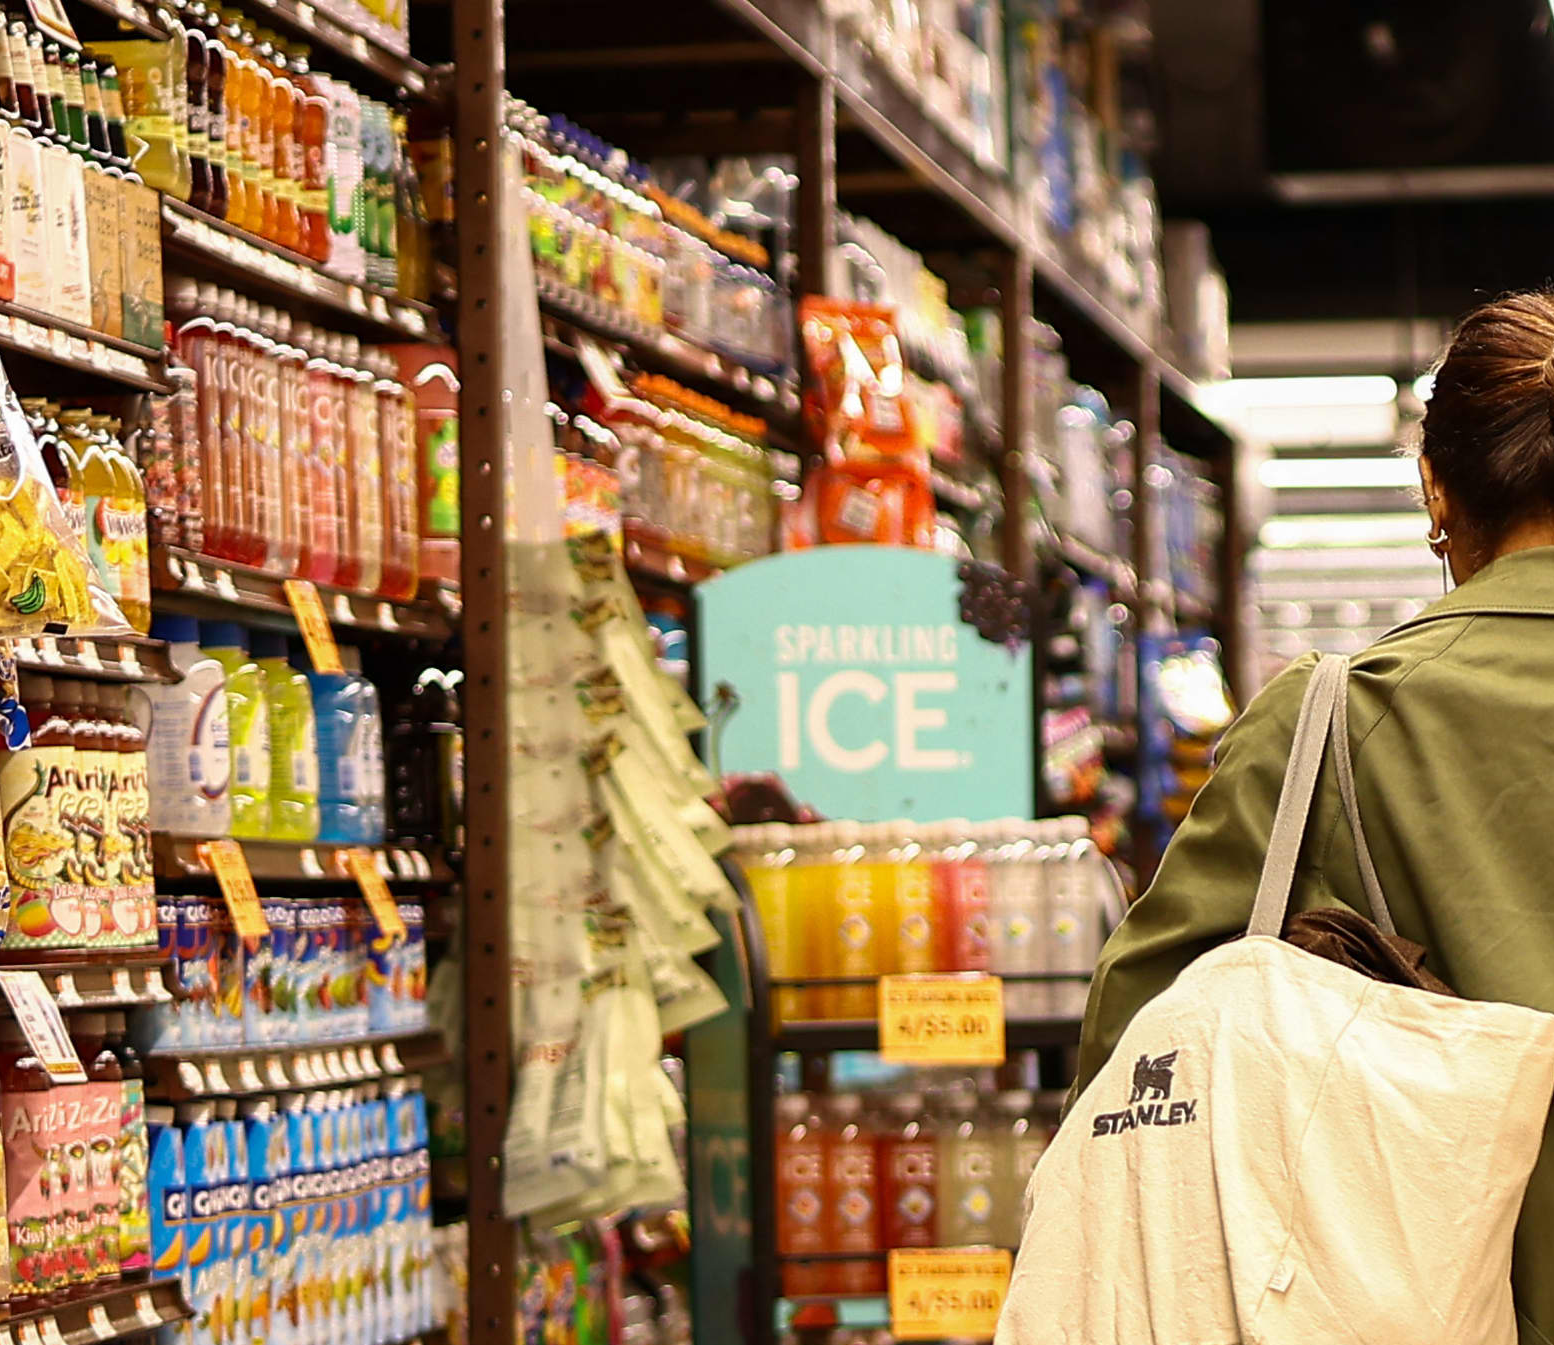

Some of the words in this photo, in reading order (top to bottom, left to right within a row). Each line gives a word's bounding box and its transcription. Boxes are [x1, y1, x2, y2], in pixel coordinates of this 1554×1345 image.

[776, 625, 958, 664] SPARKLING
[779, 670, 959, 772] ICE
[1091, 1099, 1194, 1139] STANLEY
